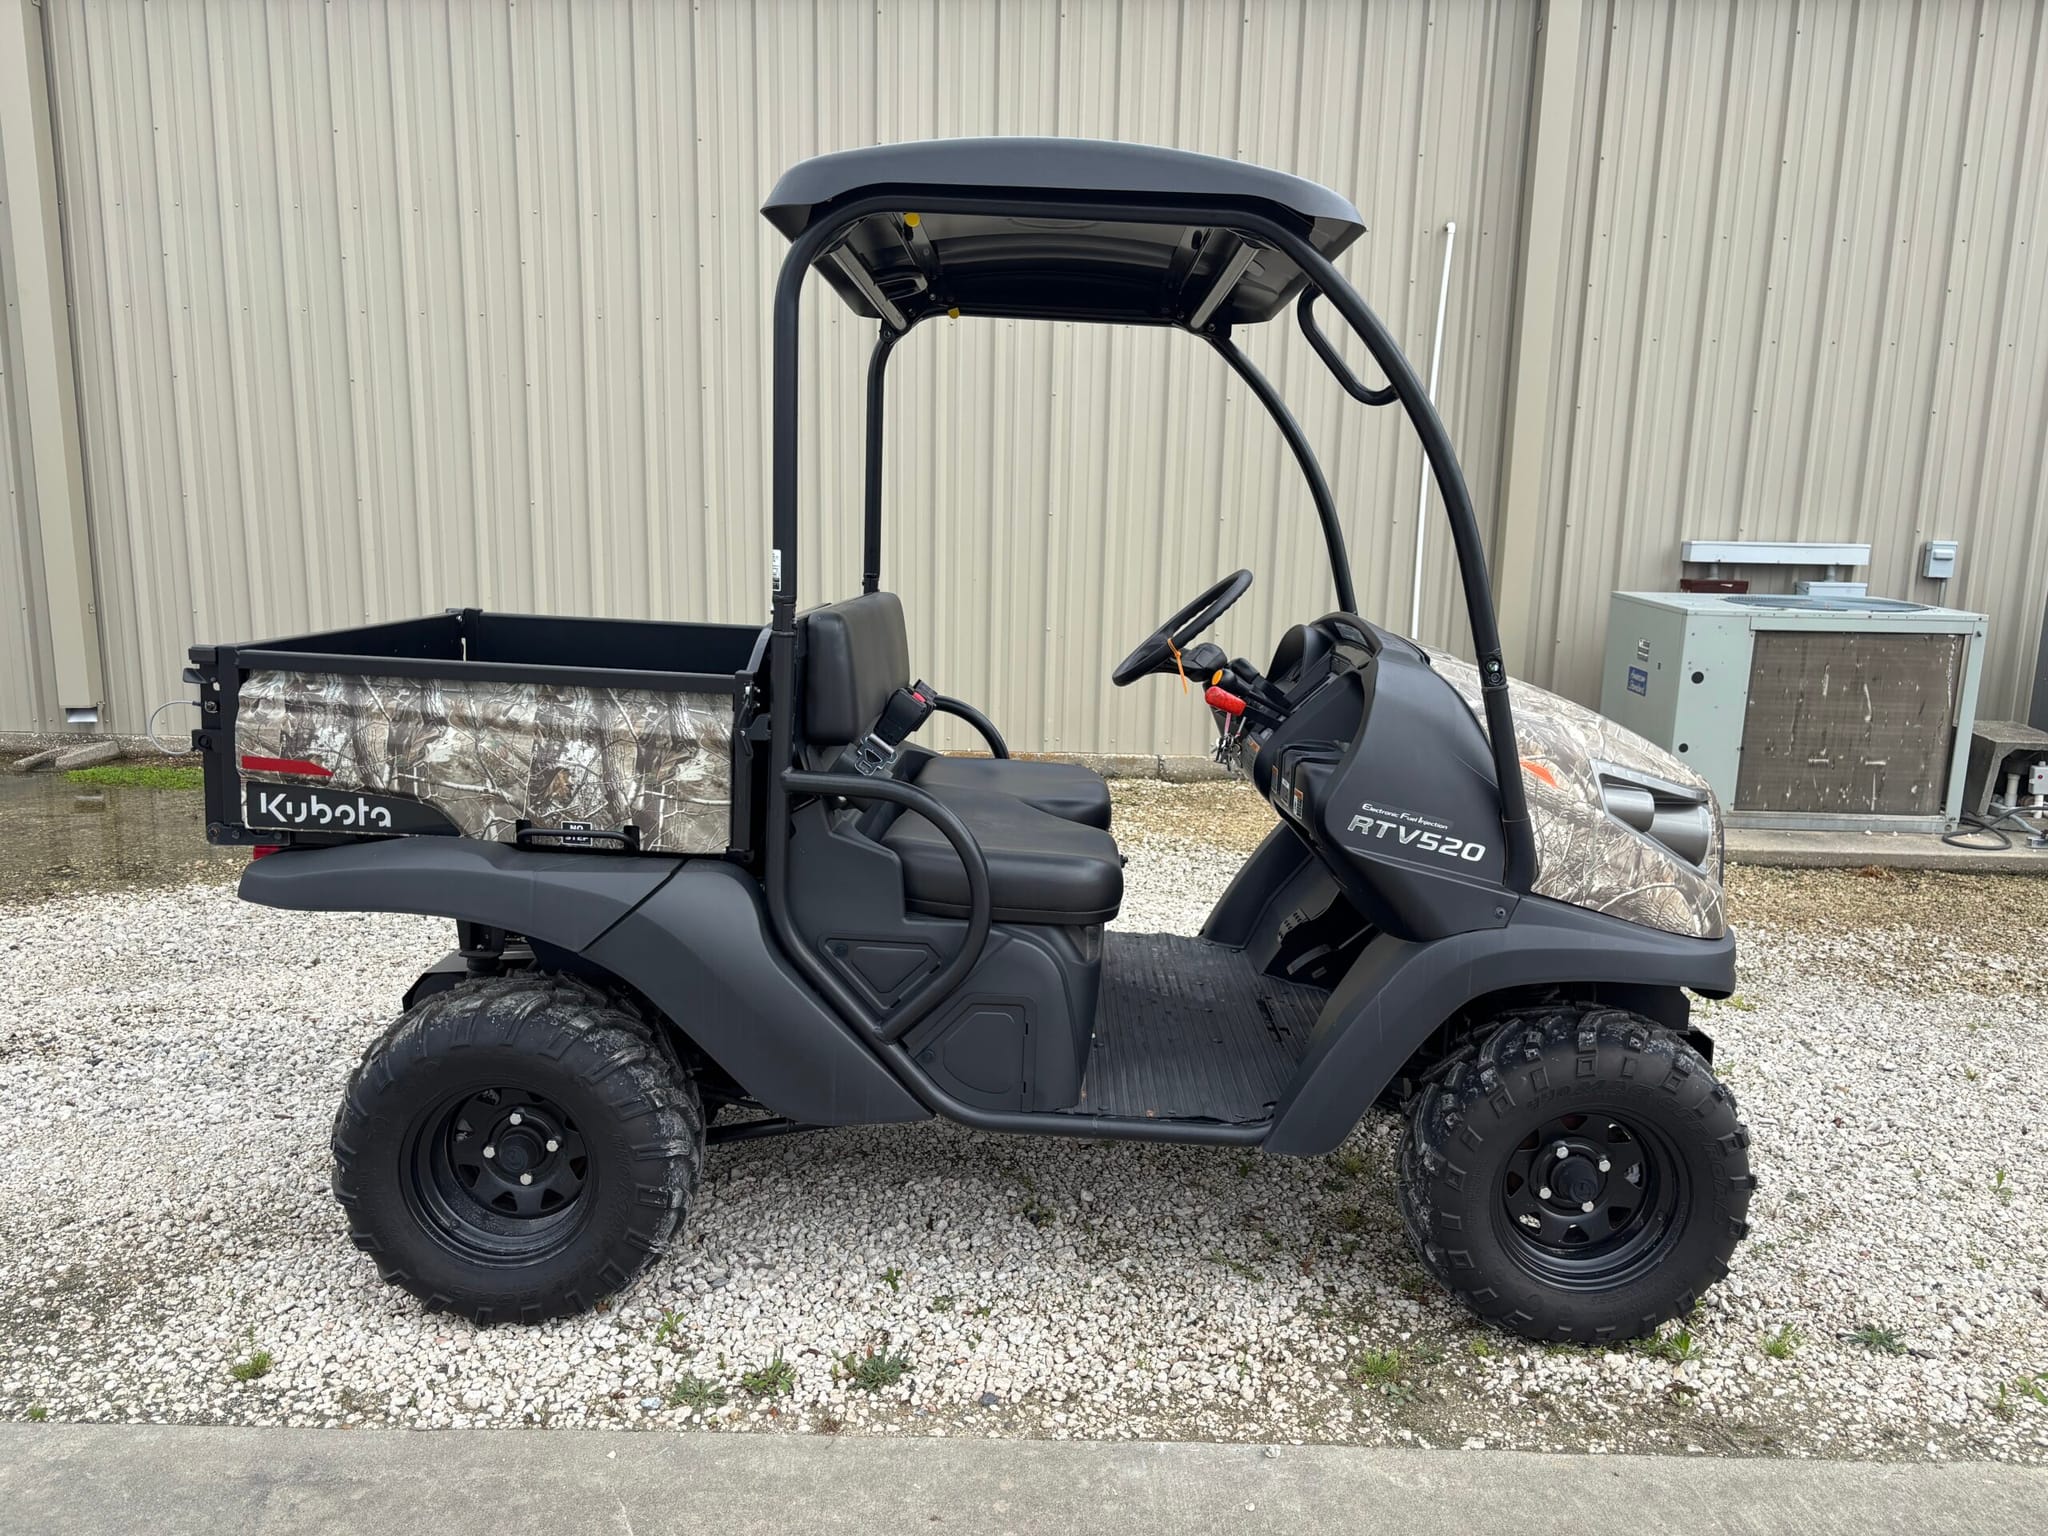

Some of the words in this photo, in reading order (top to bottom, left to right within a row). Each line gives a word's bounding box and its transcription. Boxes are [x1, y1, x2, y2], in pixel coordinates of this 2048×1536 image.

[260, 792, 392, 828] Kubota
[1362, 803, 1400, 818] Electronic
[1400, 812, 1418, 823] Fuel
[1418, 817, 1448, 829] Injection
[1347, 815, 1486, 862] RTV520
